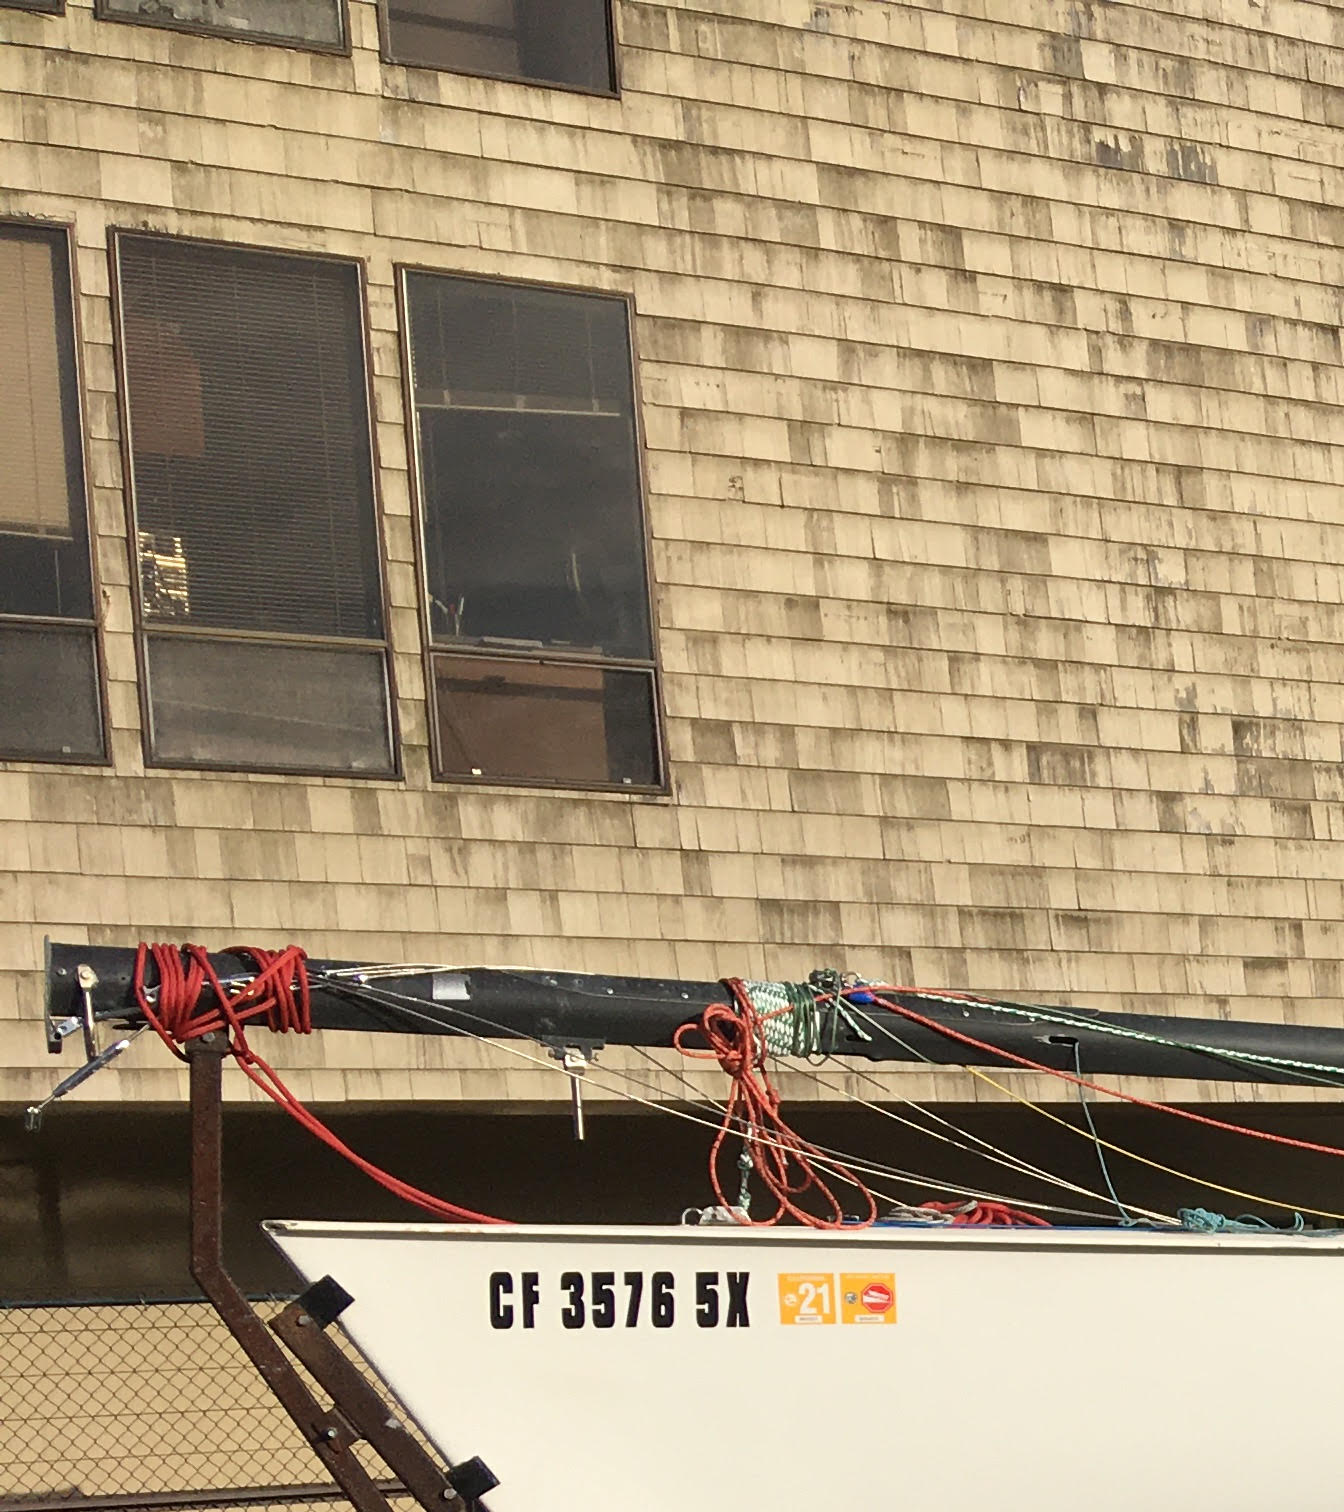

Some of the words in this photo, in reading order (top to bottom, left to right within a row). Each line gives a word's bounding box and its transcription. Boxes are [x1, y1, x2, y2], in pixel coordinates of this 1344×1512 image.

[490, 1271, 540, 1329] CF
[560, 1271, 675, 1328] 3576
[696, 1271, 750, 1328] 5X
[798, 1282, 830, 1314] 21
